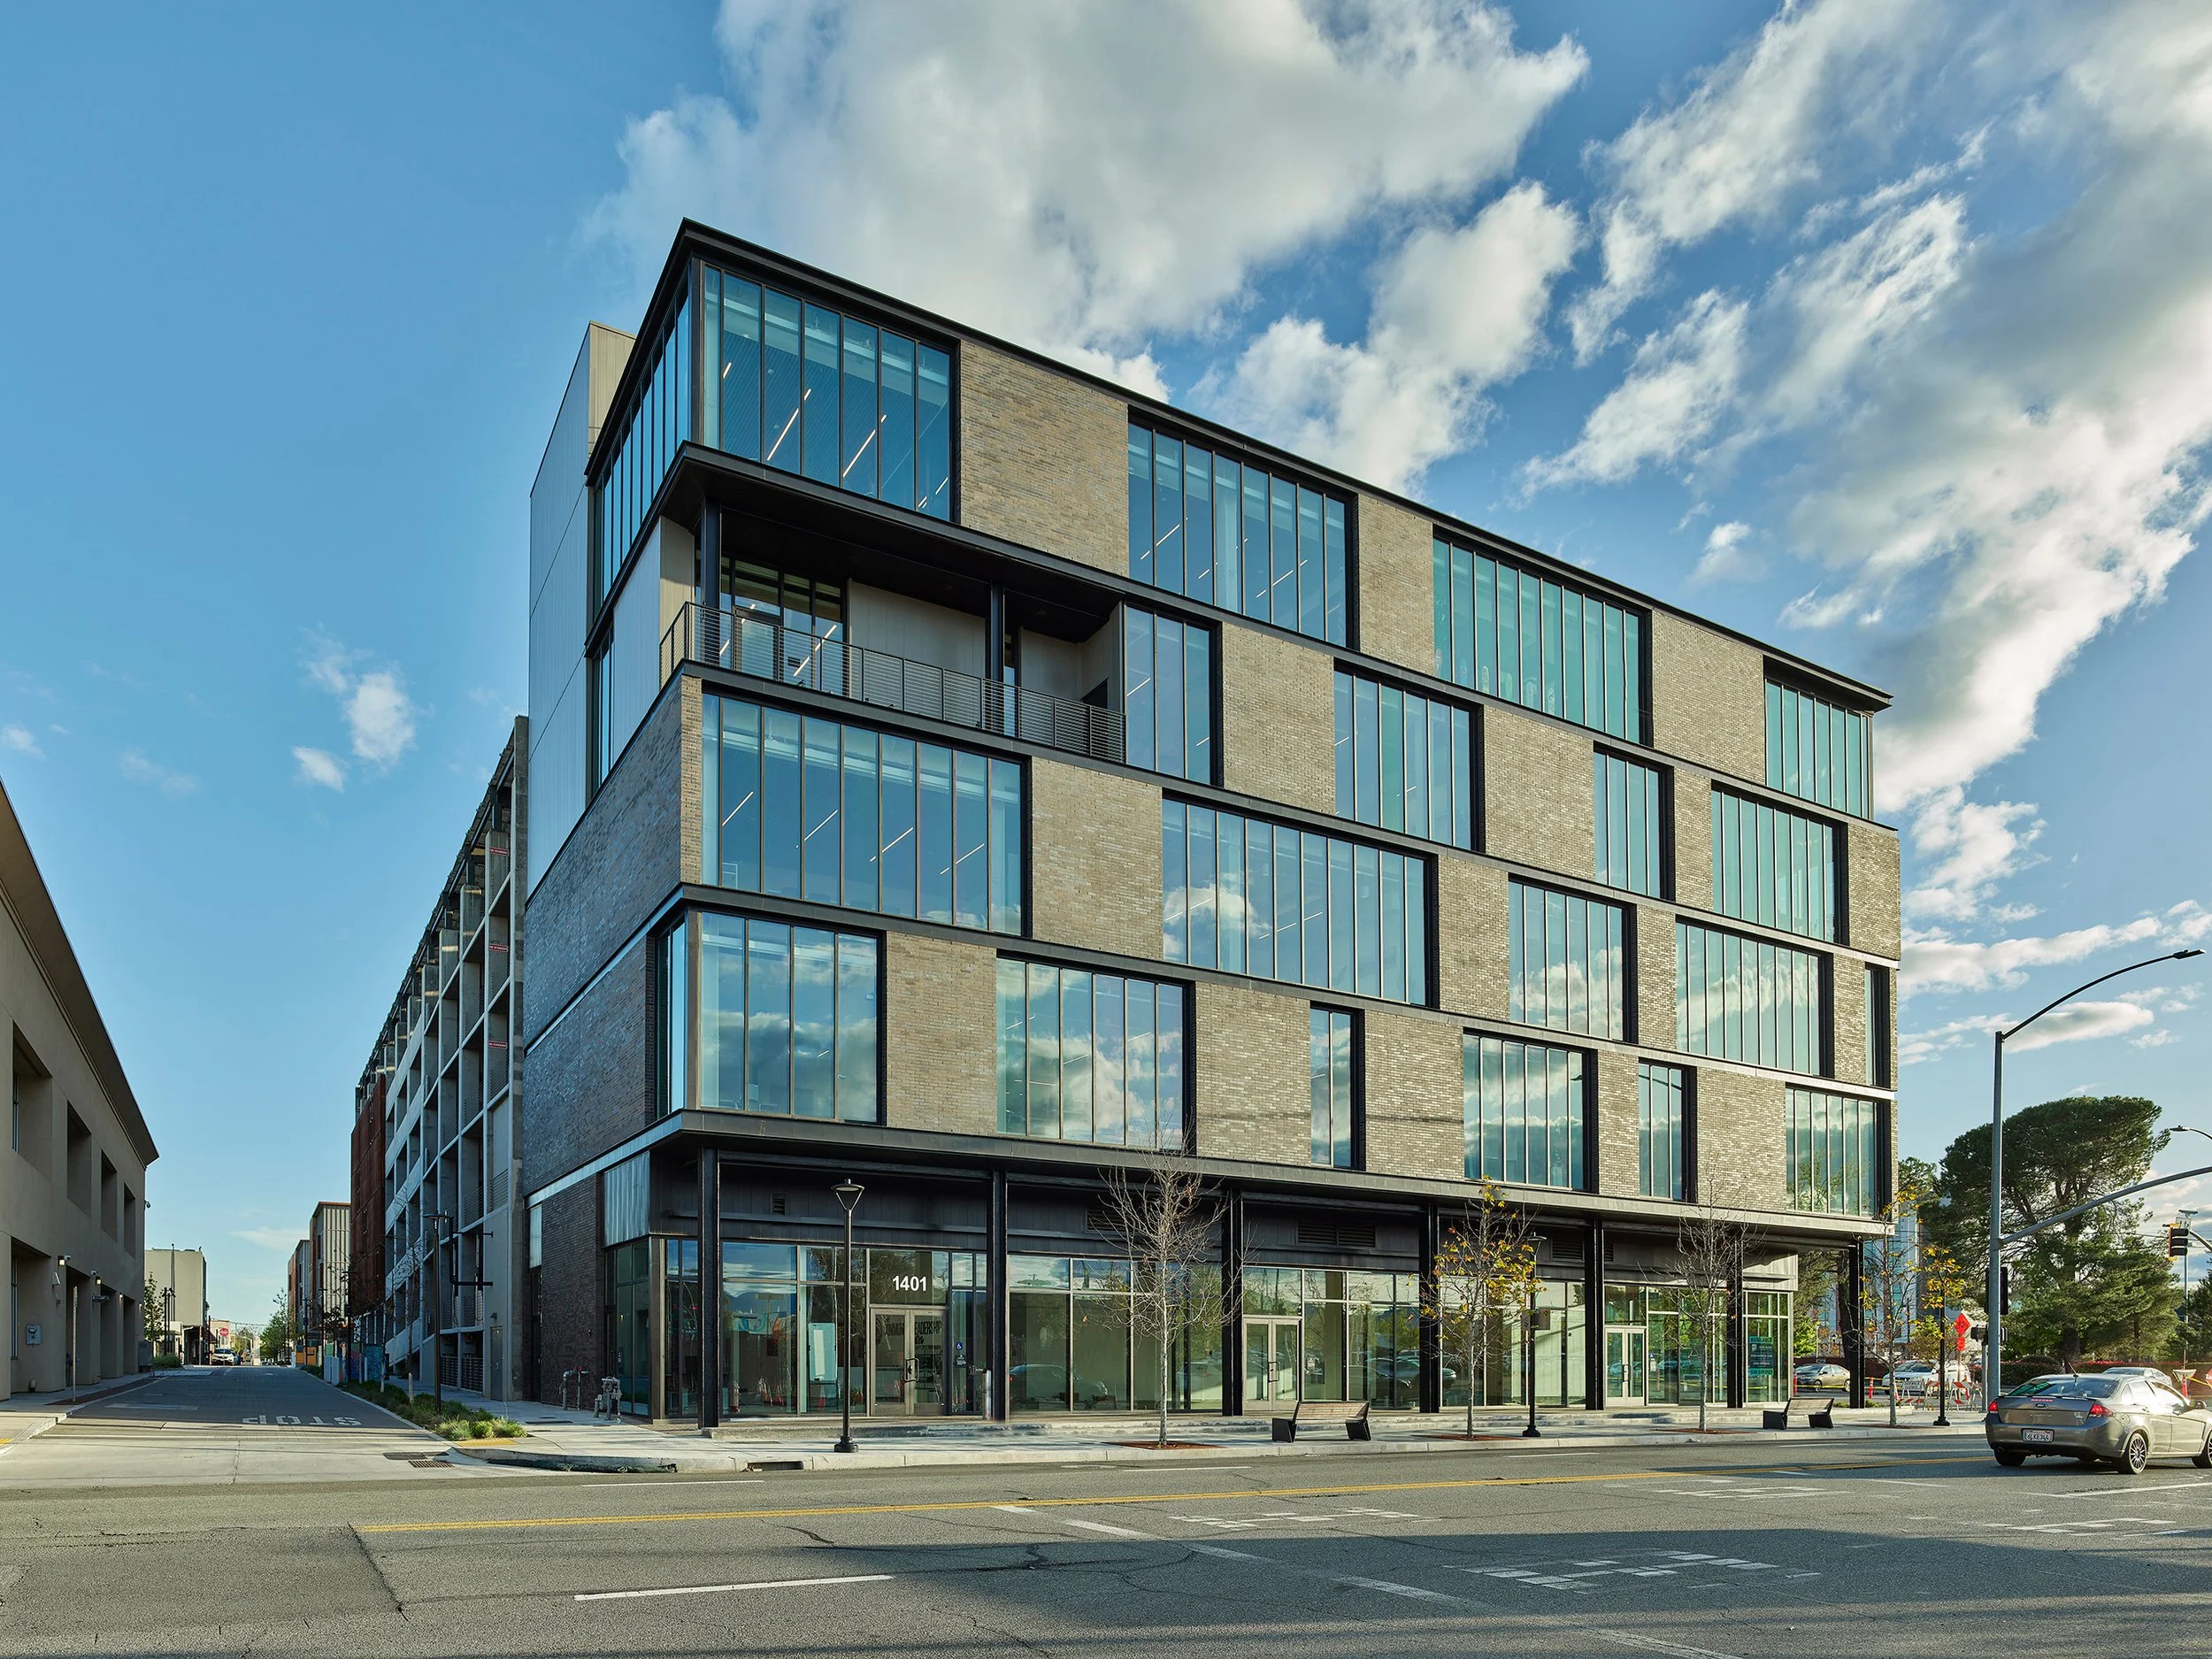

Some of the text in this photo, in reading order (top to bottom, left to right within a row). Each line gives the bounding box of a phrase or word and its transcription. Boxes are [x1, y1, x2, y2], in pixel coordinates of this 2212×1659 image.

[892, 1275, 926, 1292] 1401
[914, 1320, 942, 1335] EADERSHIP
[242, 1415, 362, 1425] STOP
